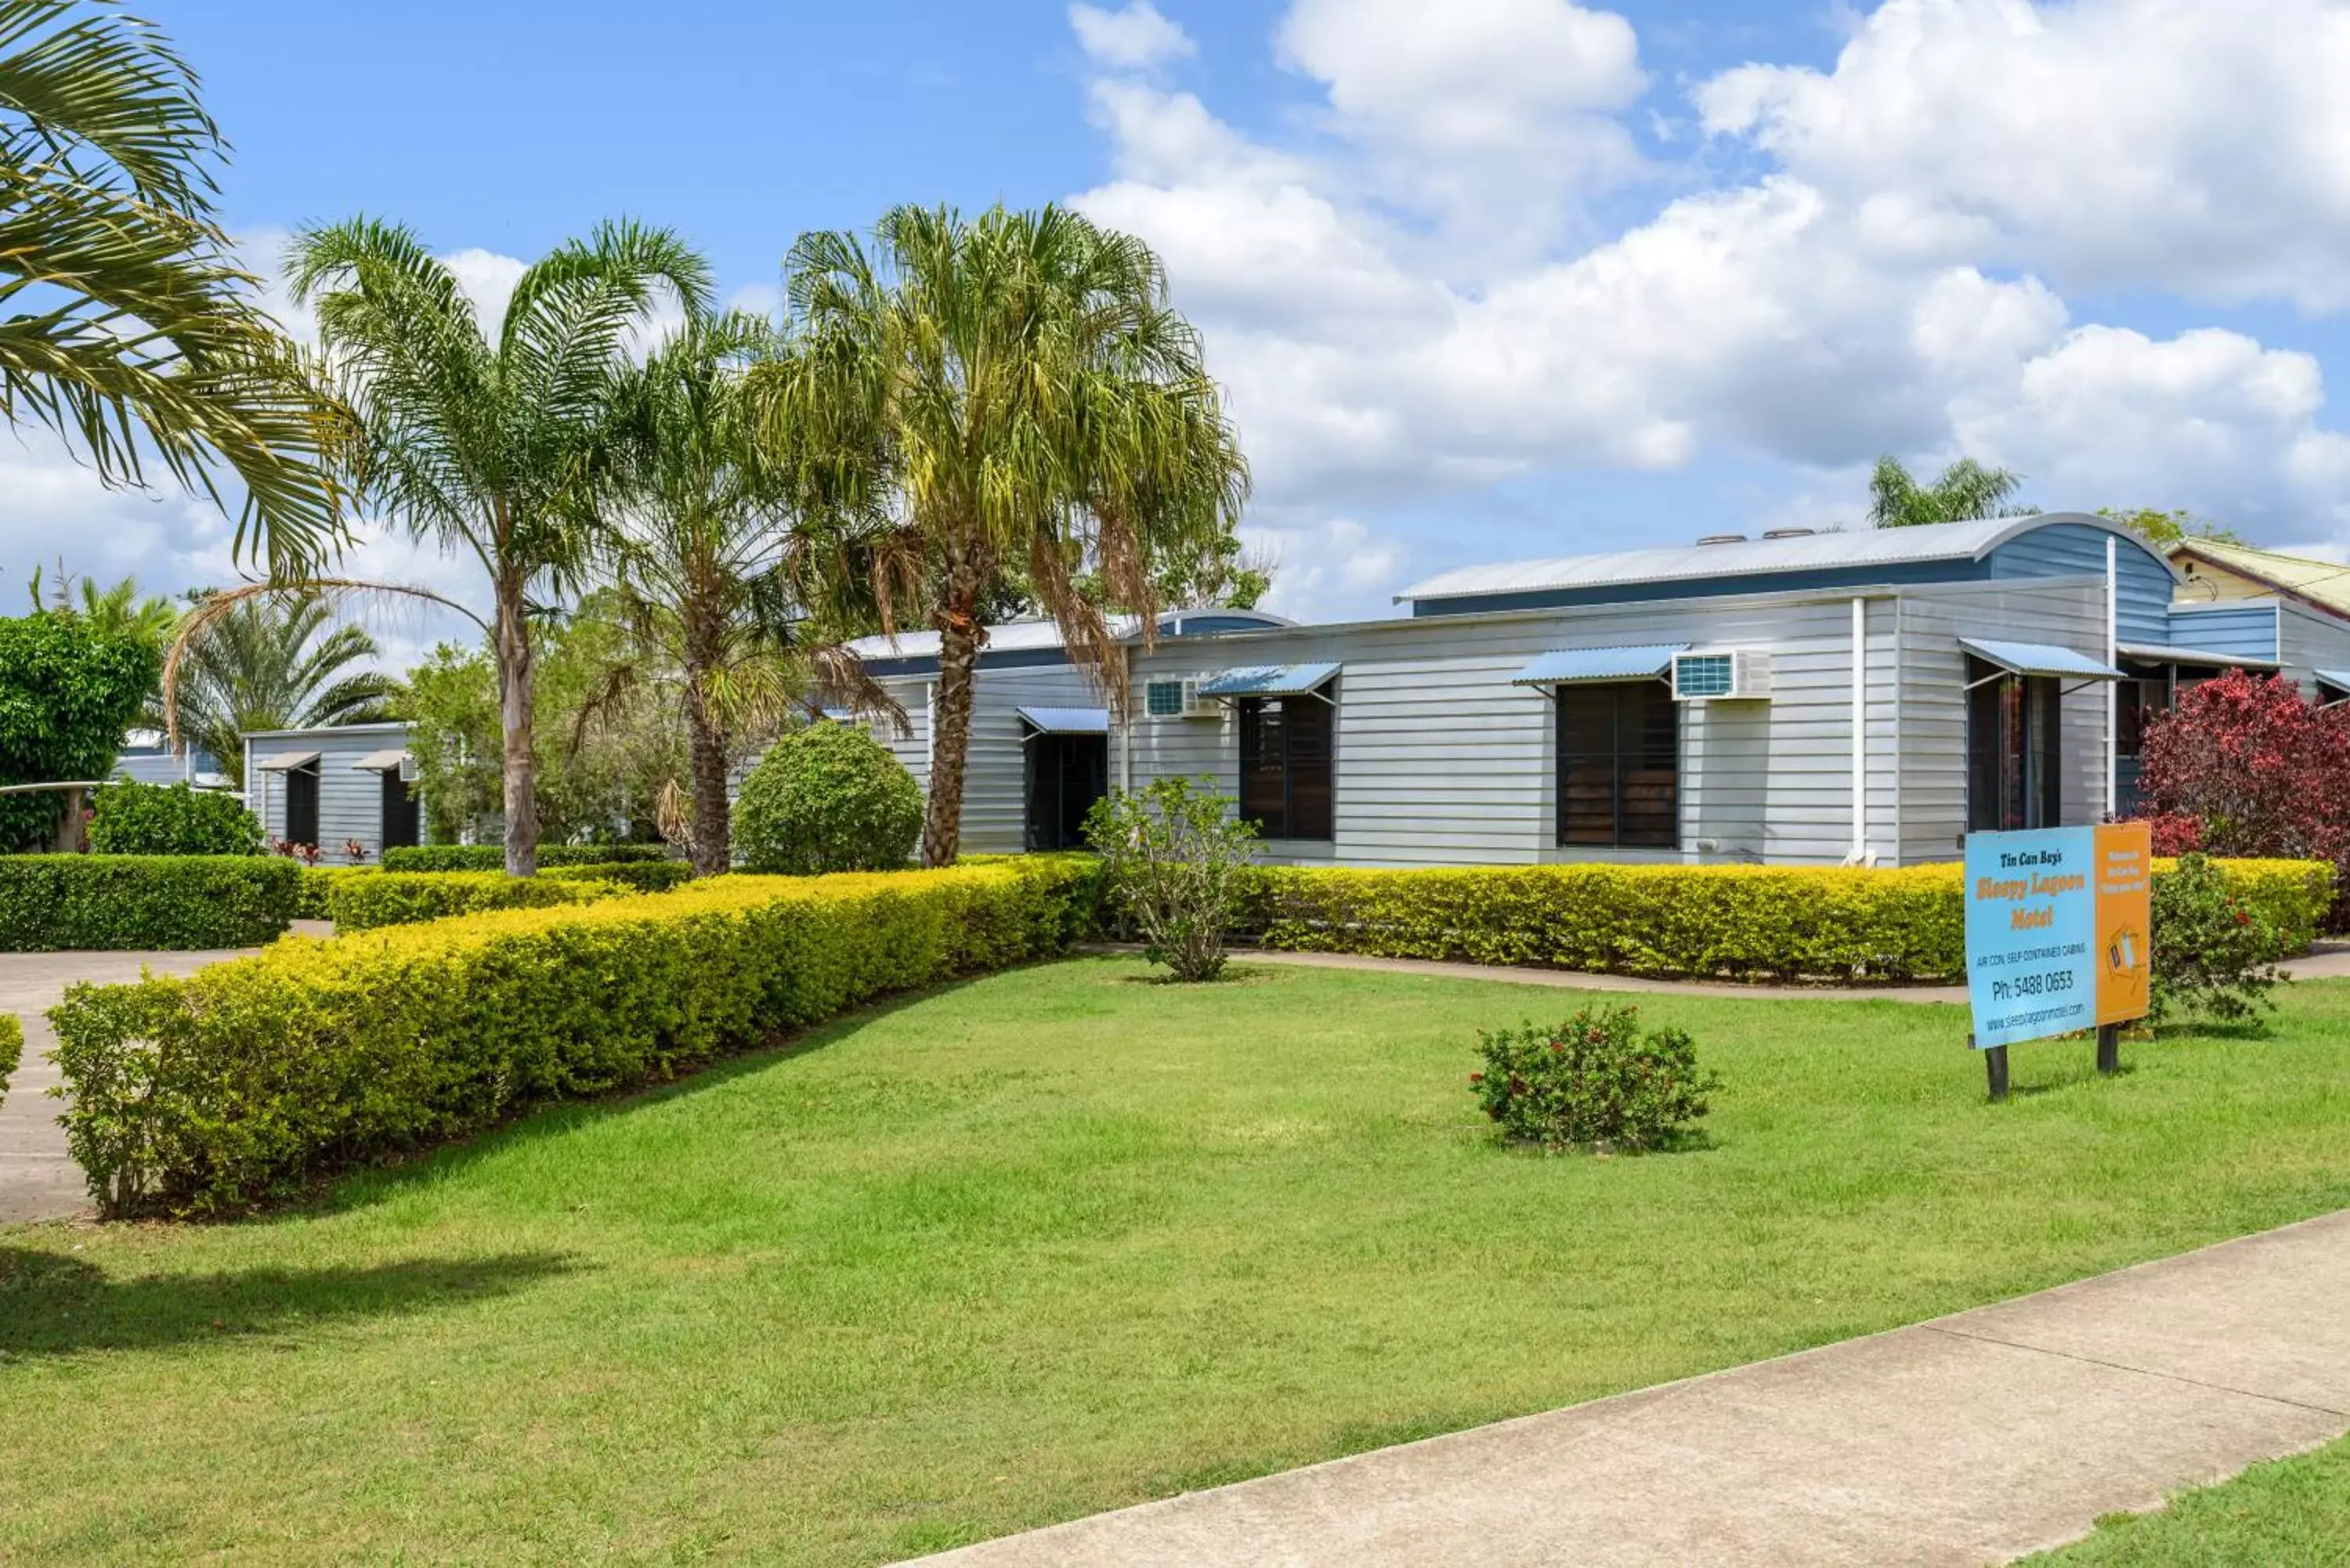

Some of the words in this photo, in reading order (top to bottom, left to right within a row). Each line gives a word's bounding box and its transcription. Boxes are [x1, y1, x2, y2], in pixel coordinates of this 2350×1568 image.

[2000, 853, 2017, 868] Tin
[2019, 851, 2037, 866] Can
[2040, 847, 2063, 866] Bay's
[1976, 877, 2027, 901] Sleepy
[2030, 873, 2085, 897] Lagoon
[2011, 905, 2052, 930] Motel
[1976, 956, 1987, 970] AIR
[1992, 980, 2012, 1002] Ph:
[2014, 974, 2043, 998] 5488
[2045, 970, 2073, 993] 0653
